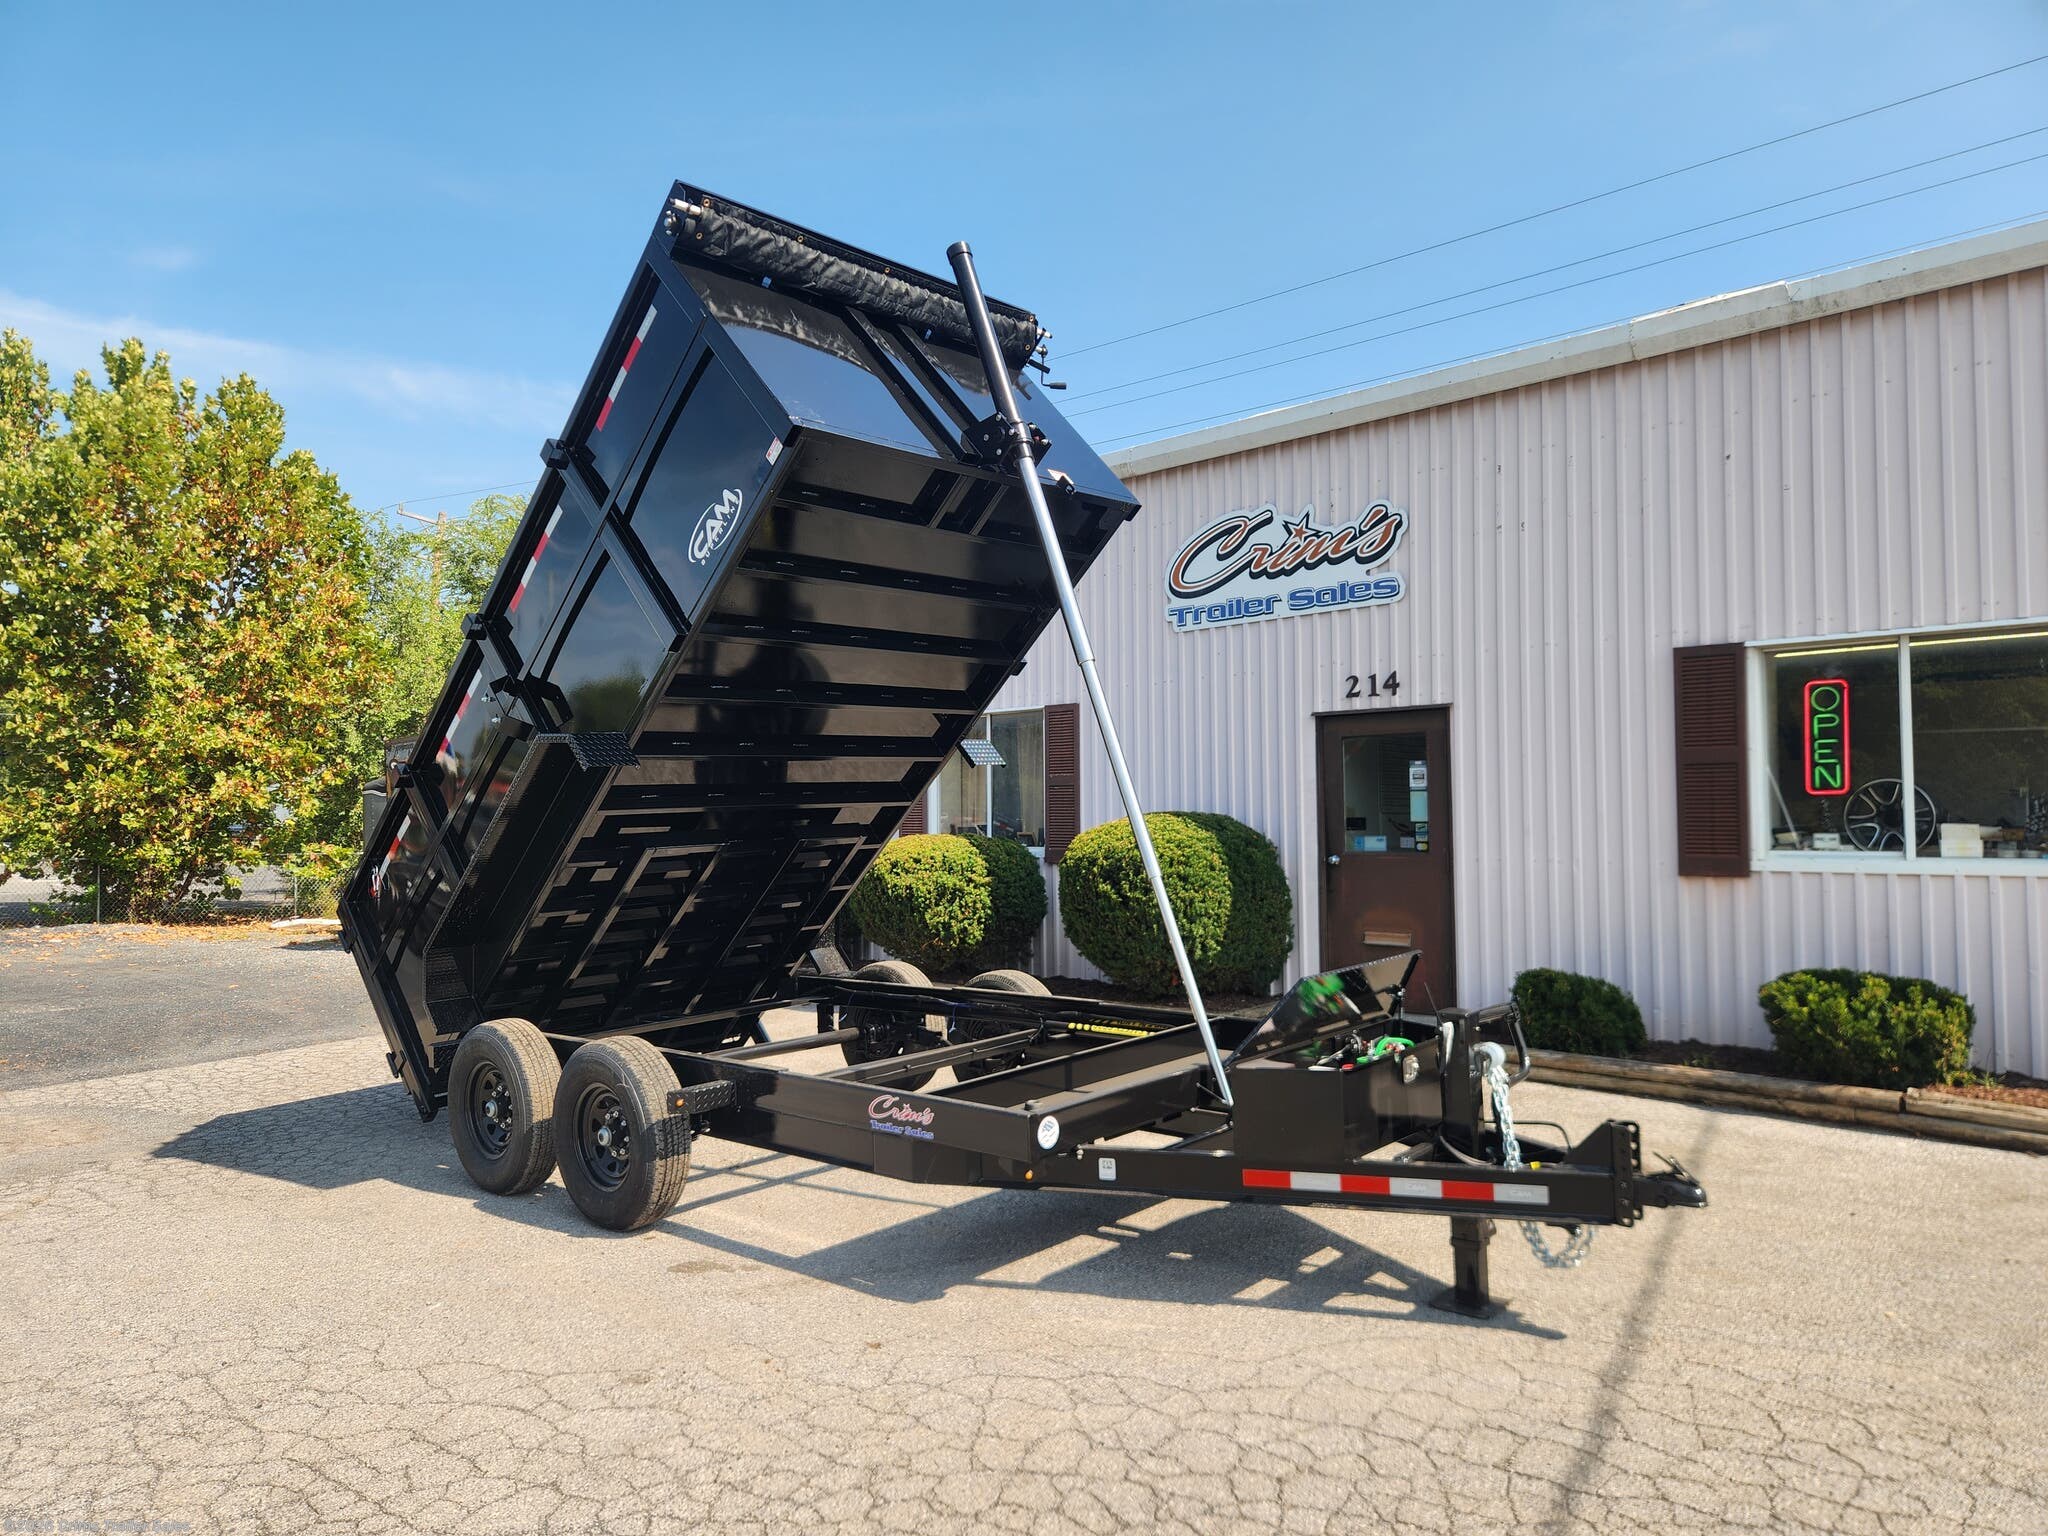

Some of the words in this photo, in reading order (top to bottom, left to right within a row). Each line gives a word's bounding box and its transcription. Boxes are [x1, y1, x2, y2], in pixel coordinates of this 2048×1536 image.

[693, 488, 739, 559] CAM
[1169, 503, 1403, 599] Crim's
[1168, 594, 1282, 627] Trailer
[1287, 577, 1401, 611] Sales
[1345, 670, 1400, 699] 214
[1811, 686, 1842, 788] OPEN
[868, 1094, 935, 1125] Crim's
[869, 1119, 904, 1135] Trailer
[904, 1126, 935, 1141] Sales
